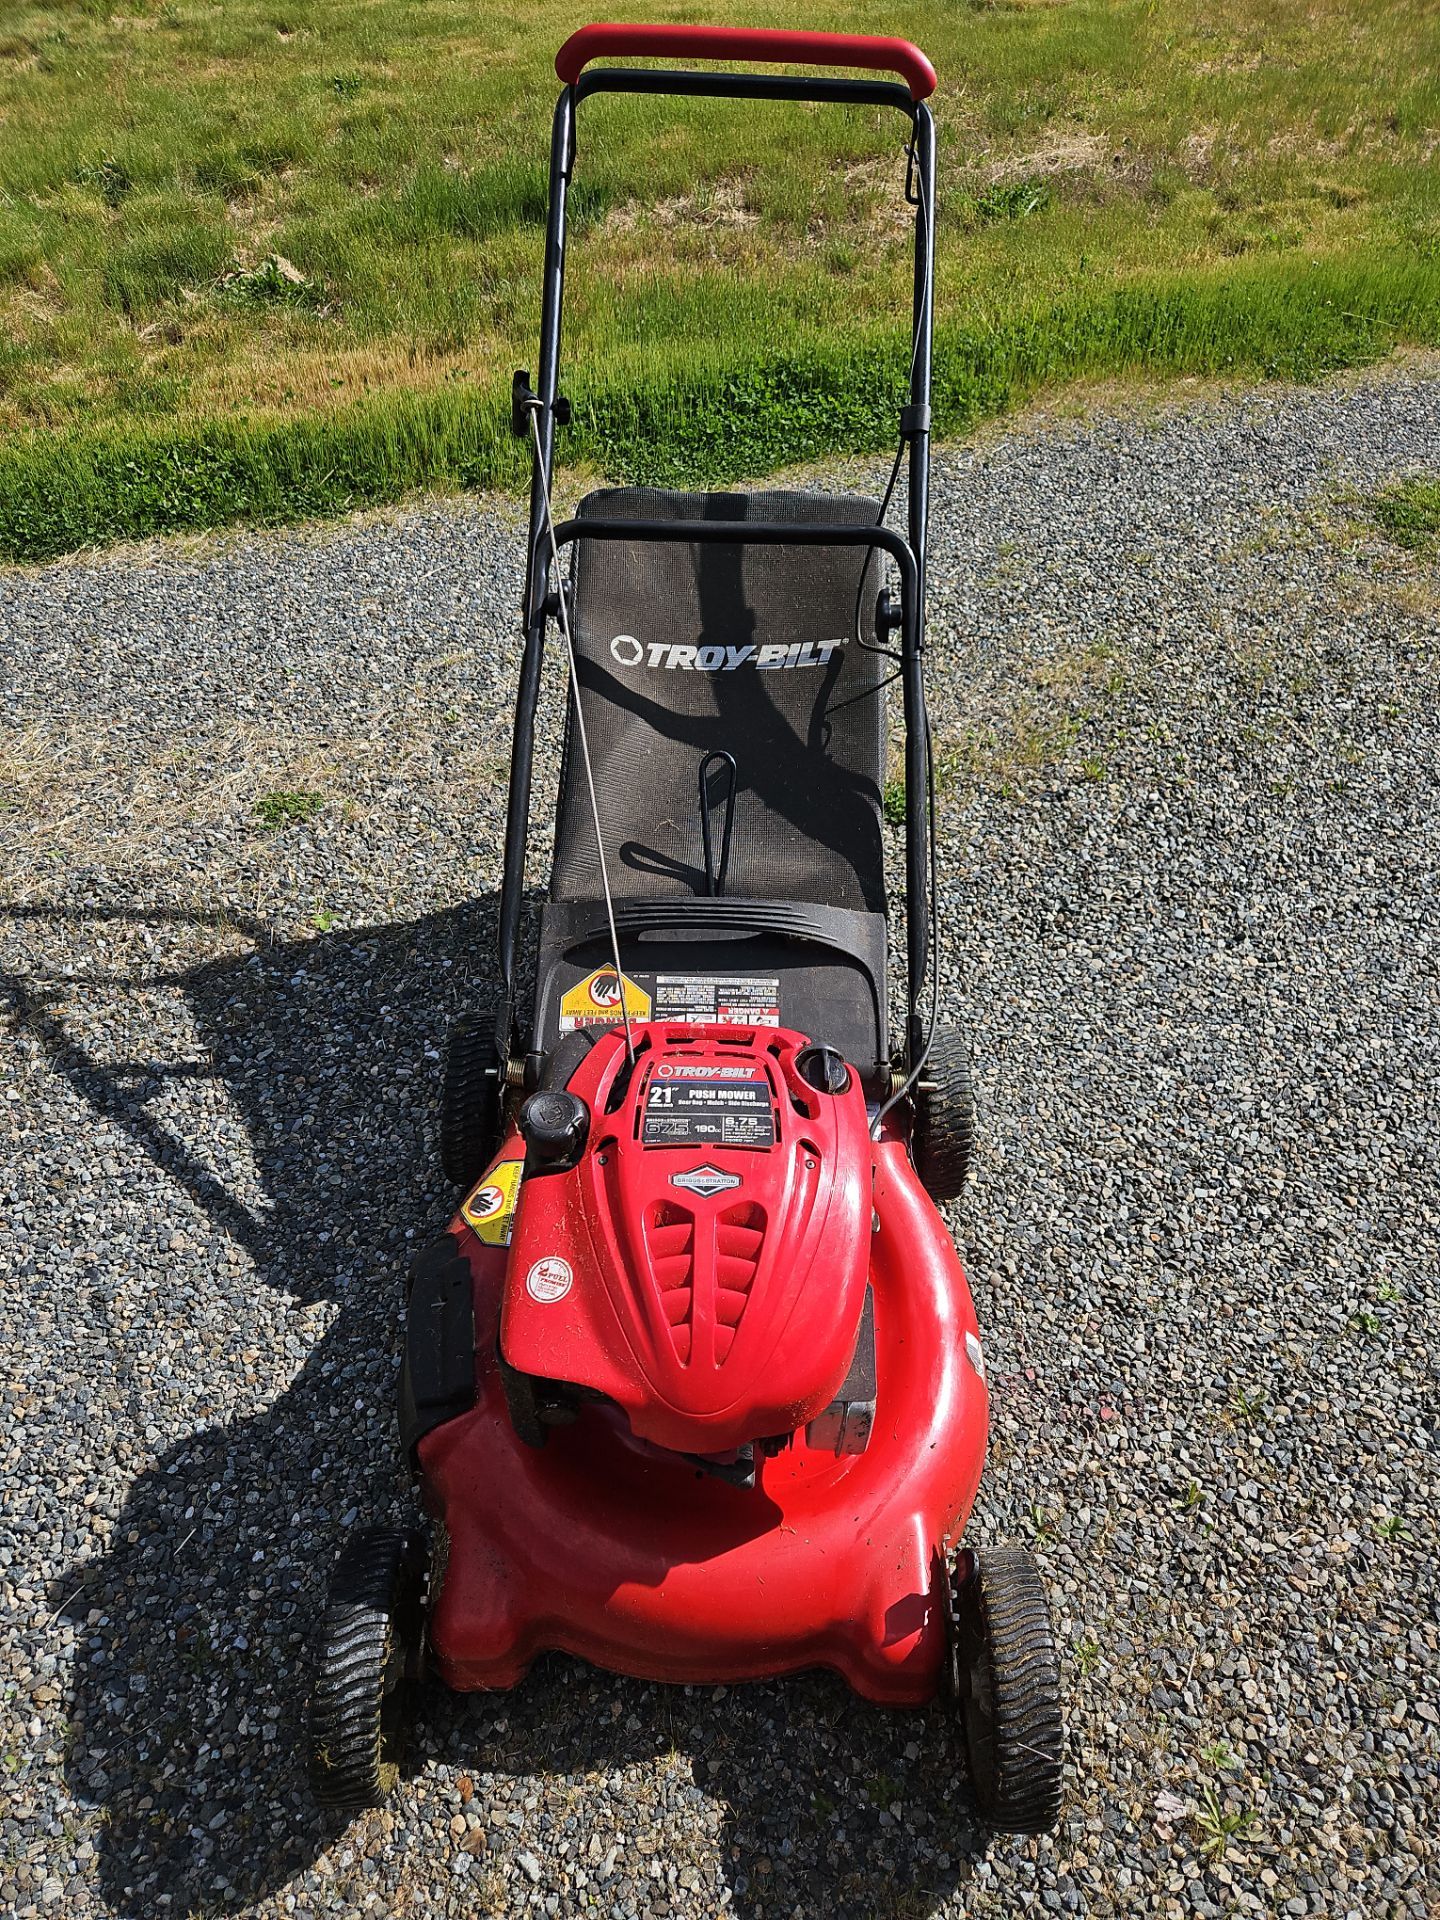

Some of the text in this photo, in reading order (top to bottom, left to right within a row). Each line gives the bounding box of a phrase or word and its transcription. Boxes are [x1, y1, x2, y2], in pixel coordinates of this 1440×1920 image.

[647, 638, 842, 671] TROY-BILT
[728, 1007, 761, 1015] DANGER
[673, 1066, 757, 1078] TROY-BILT
[689, 1089, 757, 1101] PUSH MOWER
[725, 1117, 758, 1125] 6.75
[645, 1122, 689, 1135] 675
[548, 1272, 567, 1283] PULL
